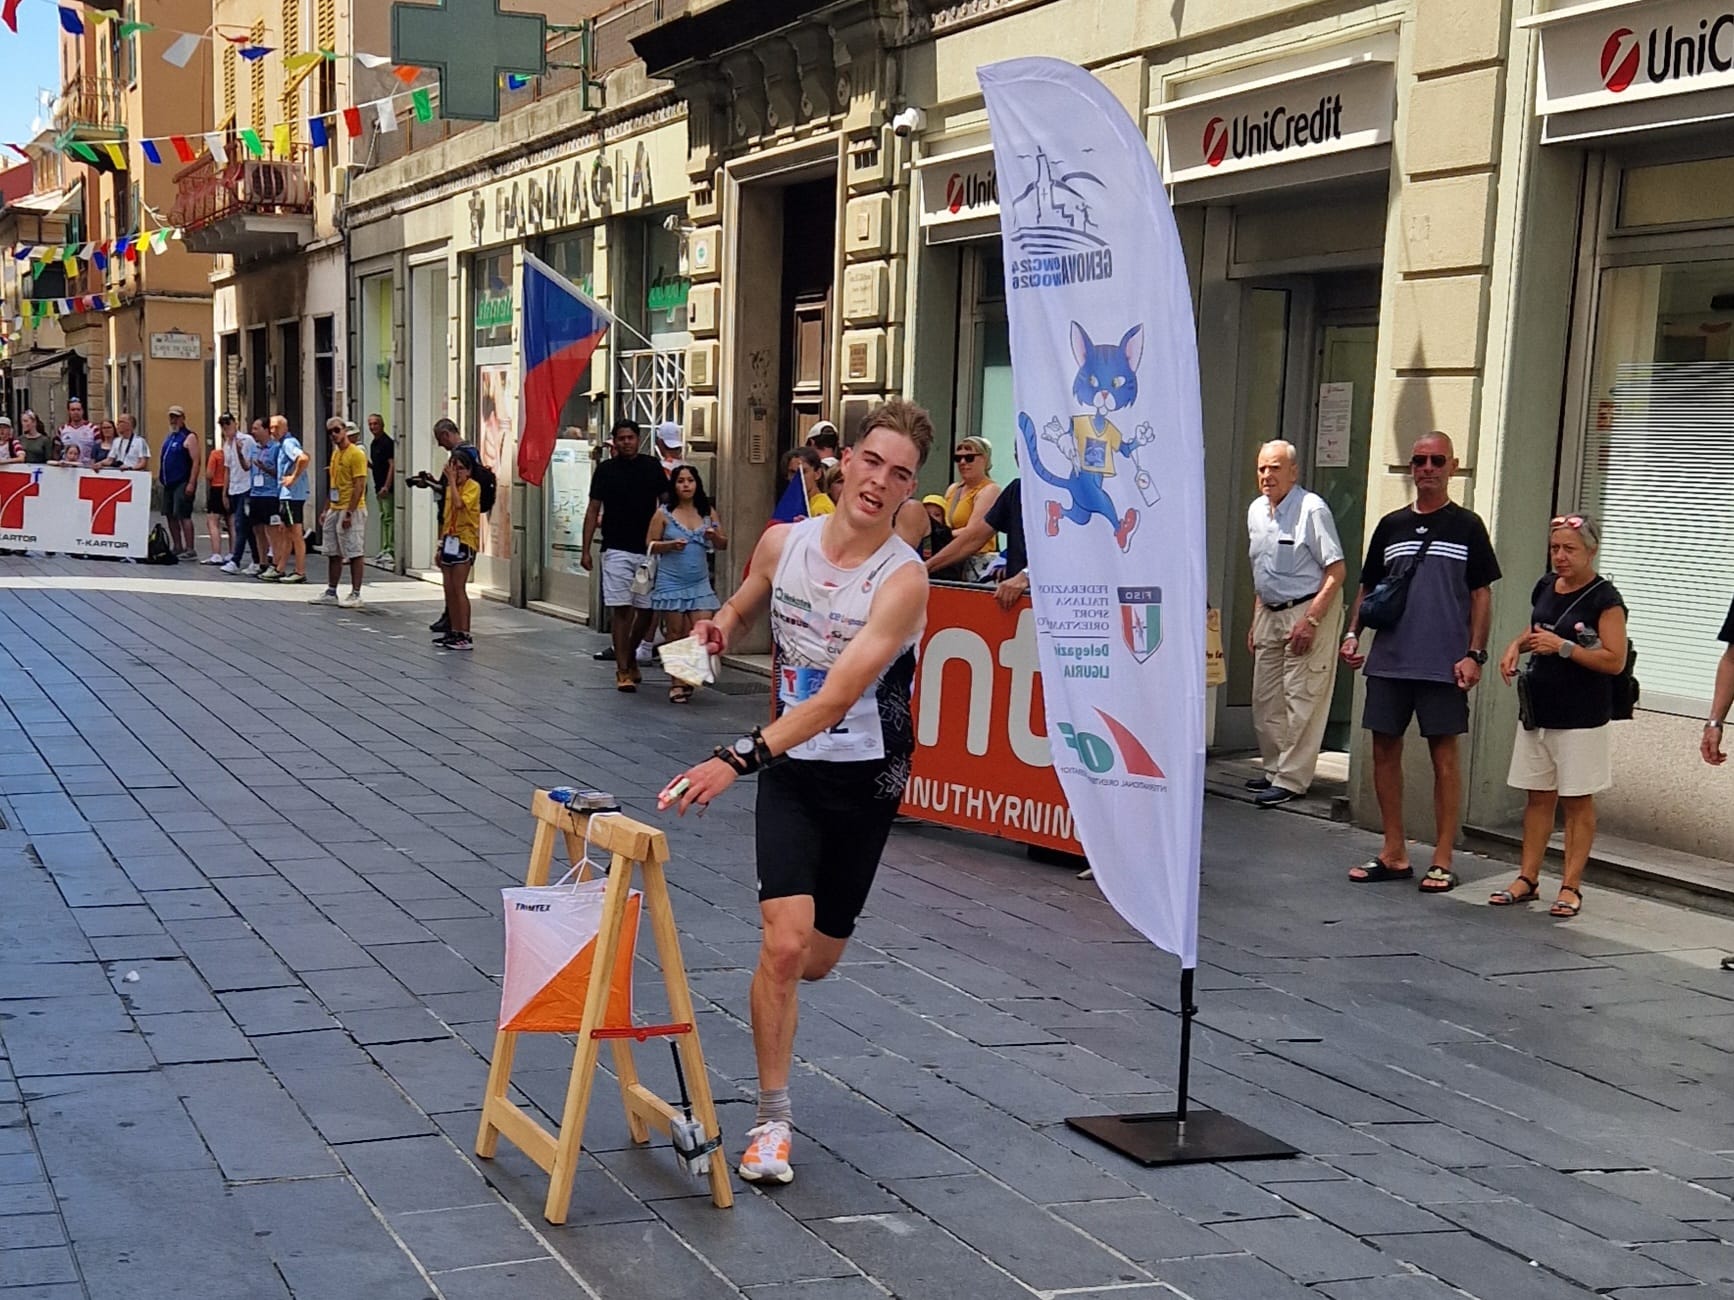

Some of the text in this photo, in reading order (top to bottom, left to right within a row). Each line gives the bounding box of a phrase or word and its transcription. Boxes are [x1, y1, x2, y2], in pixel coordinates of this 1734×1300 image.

[1647, 14, 1734, 84] UniC
[1232, 94, 1342, 160] UniCredit
[496, 141, 654, 234] FARMACIA
[0, 534, 37, 543] ARTOR
[75, 538, 129, 549] T-KARTOR
[903, 775, 1083, 843] INUTHYRNIN
